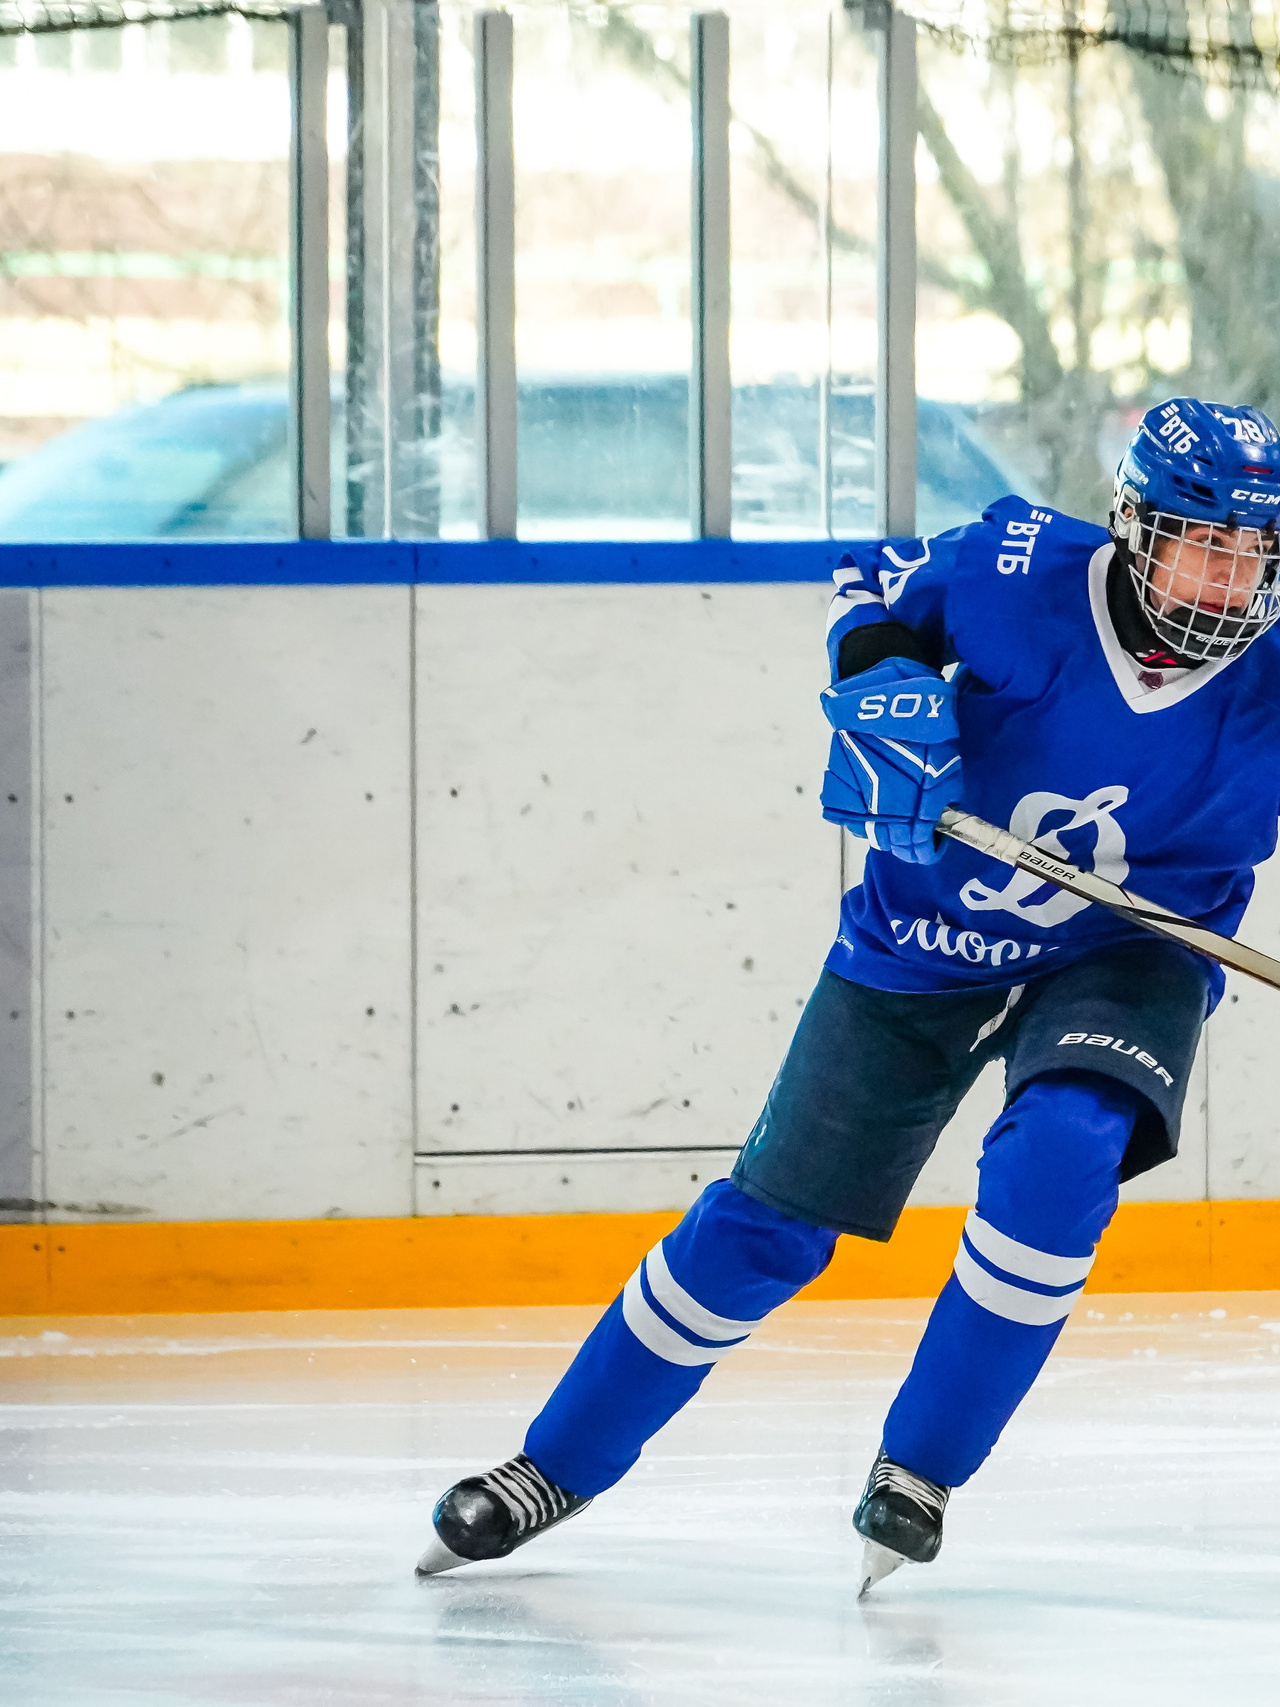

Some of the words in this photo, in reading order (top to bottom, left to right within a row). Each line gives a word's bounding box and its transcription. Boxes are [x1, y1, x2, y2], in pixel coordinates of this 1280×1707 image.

[1158, 416, 1200, 455] ВТБ
[1221, 417, 1266, 443] 78
[996, 520, 1041, 576] ВТБ
[857, 693, 944, 721] SOY
